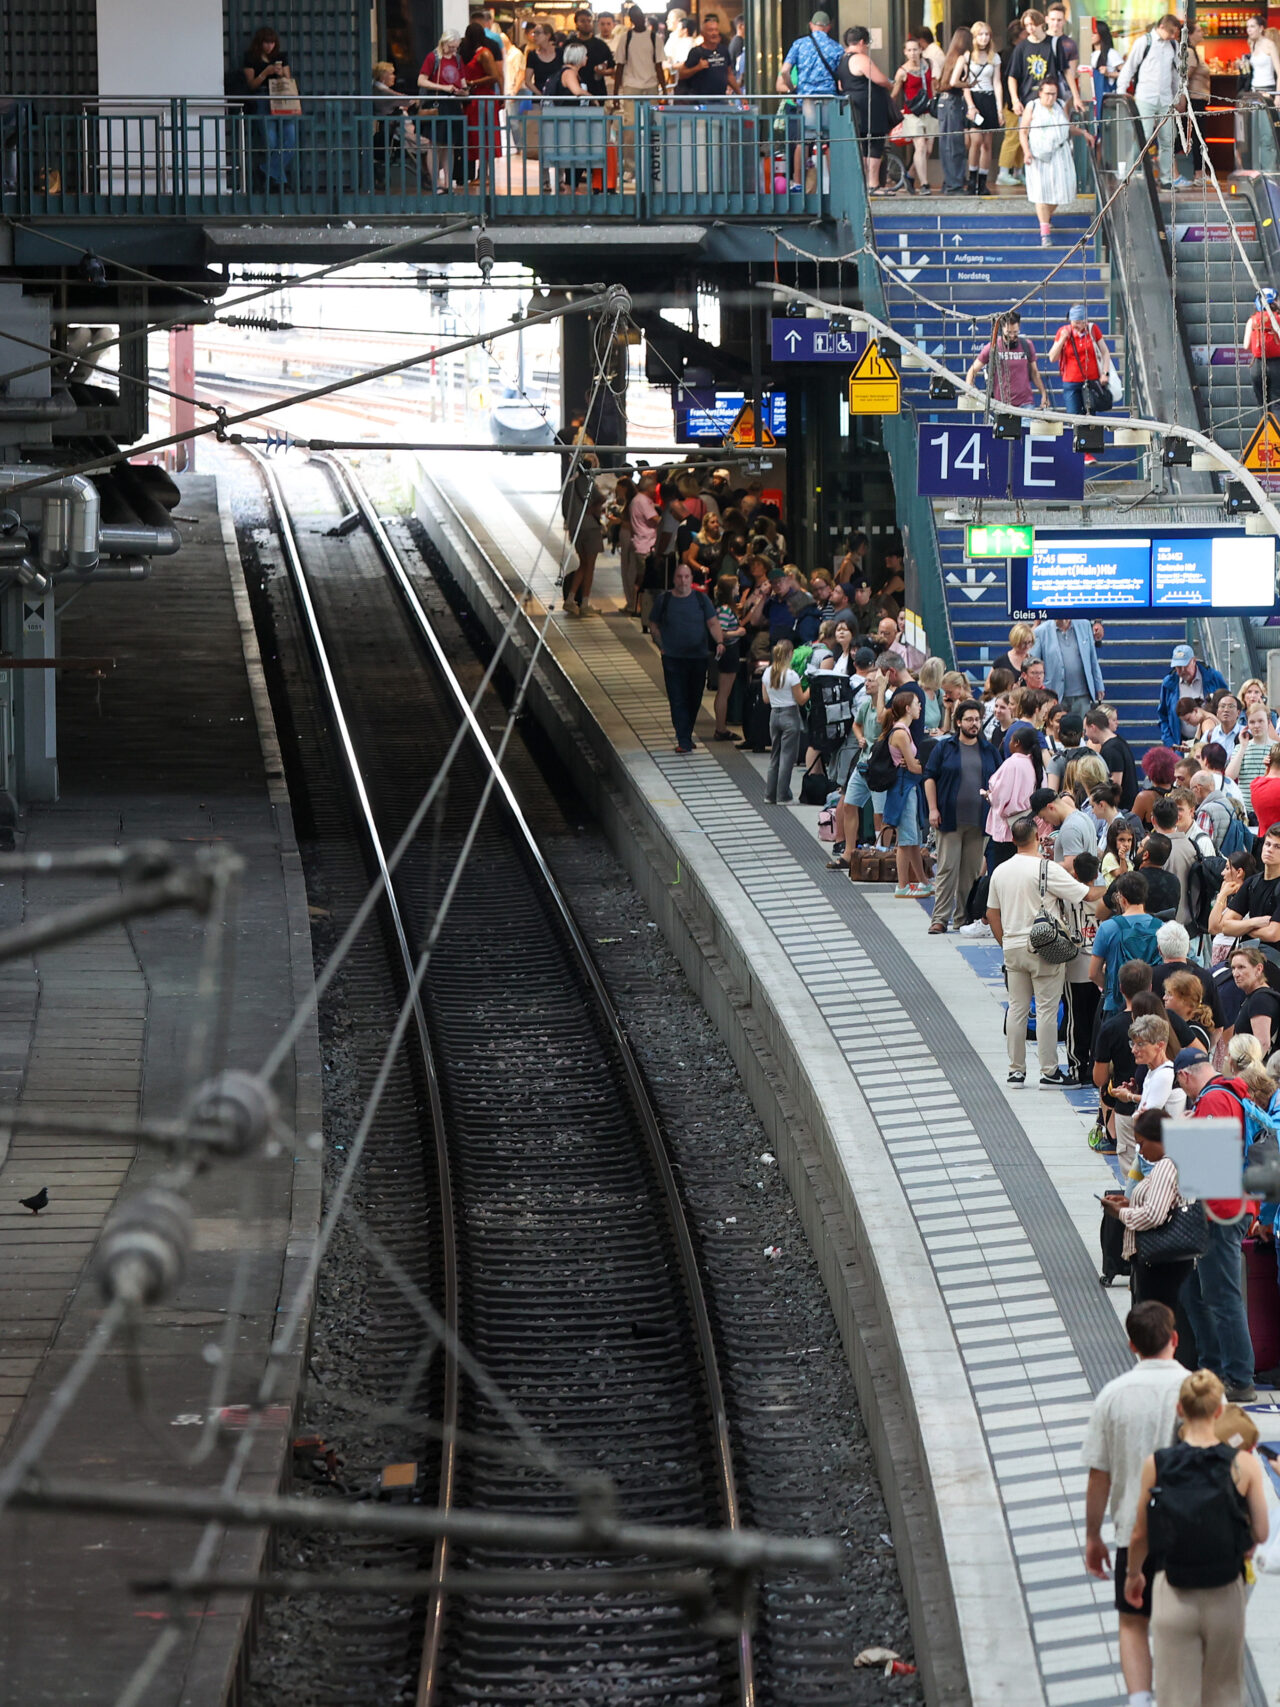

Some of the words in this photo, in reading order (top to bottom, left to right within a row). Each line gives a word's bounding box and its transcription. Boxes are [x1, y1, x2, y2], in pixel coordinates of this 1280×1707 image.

[954, 254, 984, 265] Aufgang
[958, 272, 991, 282] Nordsteg
[930, 431, 985, 480] 14
[1023, 434, 1057, 487] E
[1013, 609, 1036, 620] Gleis
[1038, 609, 1047, 619] 14
